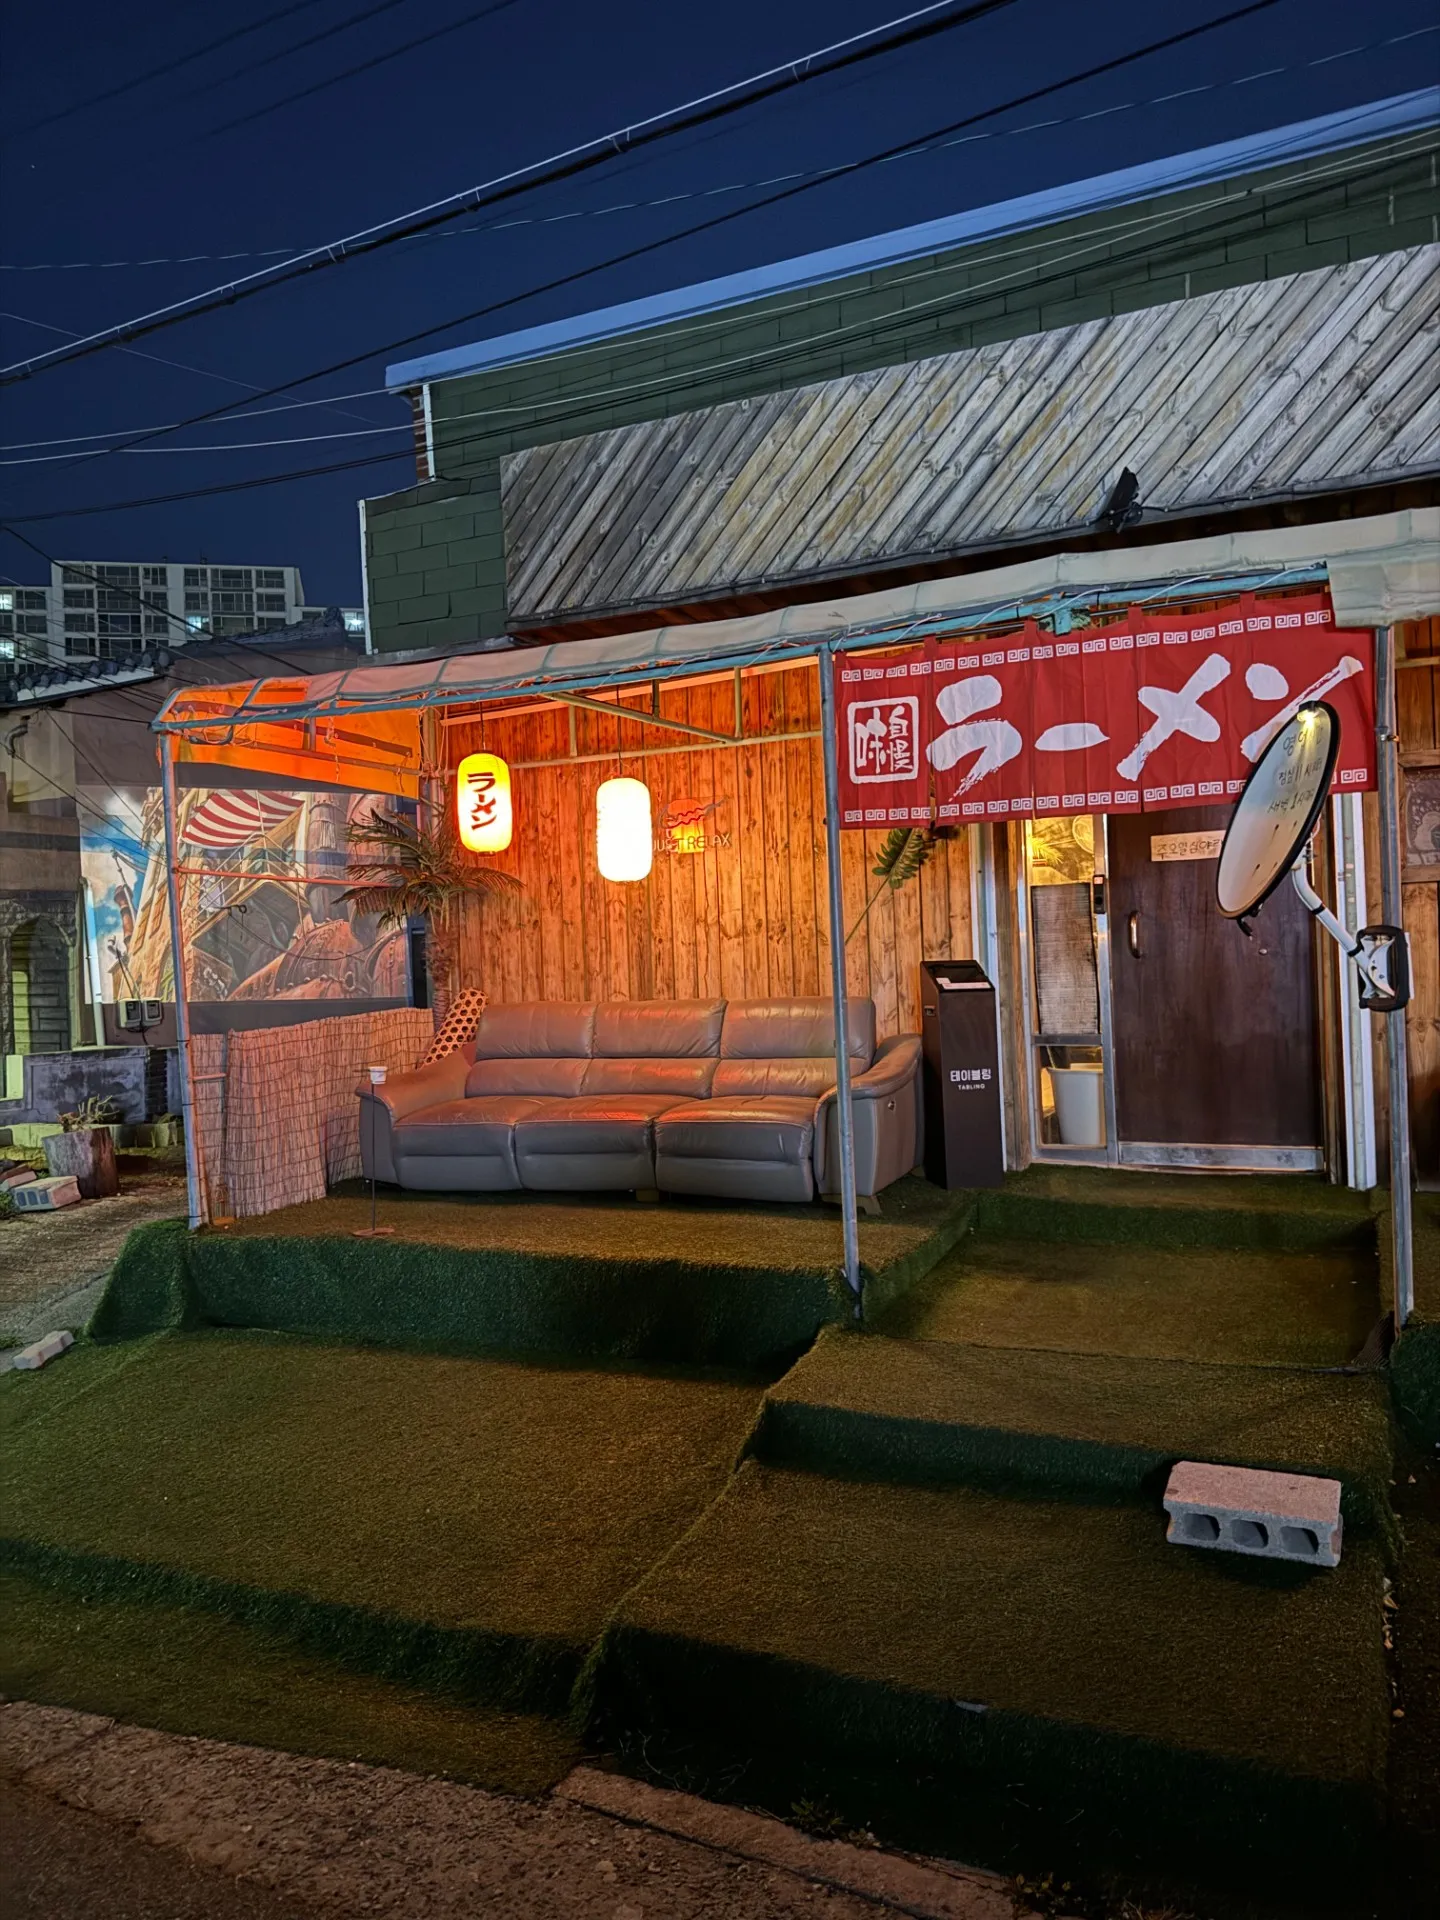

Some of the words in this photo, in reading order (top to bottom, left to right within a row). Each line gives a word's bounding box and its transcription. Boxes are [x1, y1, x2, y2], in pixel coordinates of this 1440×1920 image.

[925, 652, 1364, 802] ラーメン
[466, 771, 497, 830] ラーメン
[653, 838, 684, 852] JUST
[687, 832, 730, 850] RELAX
[950, 1069, 991, 1082] 테이블링
